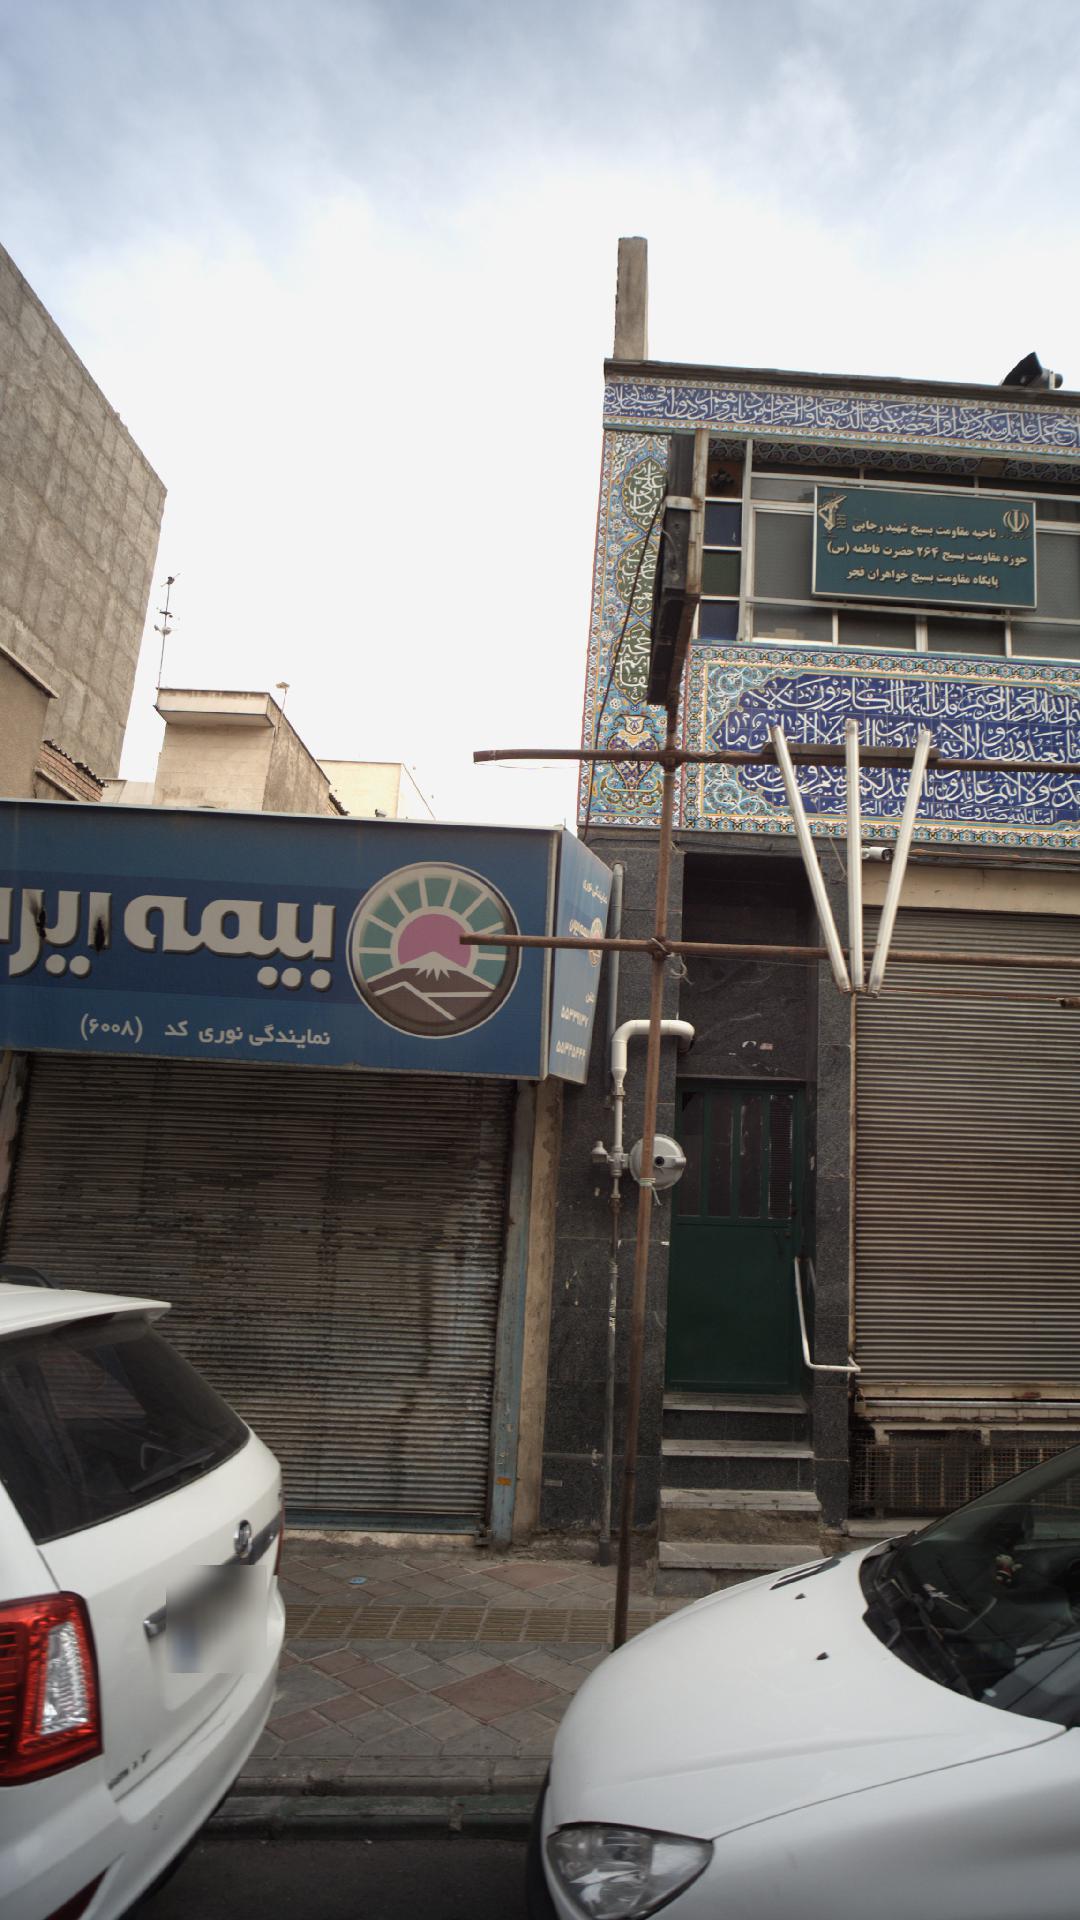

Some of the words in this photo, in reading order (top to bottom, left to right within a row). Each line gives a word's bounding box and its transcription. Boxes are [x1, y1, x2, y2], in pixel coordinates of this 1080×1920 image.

[852, 520, 884, 534] رجایی
[885, 523, 909, 534] شهید
[911, 525, 934, 536] بسیج
[936, 526, 970, 539] مقاومت
[972, 528, 997, 539] ناحیه
[827, 540, 850, 555] (س)
[853, 543, 881, 554] فاطمه
[882, 546, 914, 558] حضرت
[917, 546, 939, 558] ۲۶۴
[942, 551, 965, 563] بسیج
[966, 552, 1001, 564] مقاومت
[1003, 555, 1028, 567] حوزه
[846, 566, 865, 580] فجر
[867, 568, 909, 582] خواهران
[911, 573, 934, 584] بسیج
[936, 573, 971, 587] مقاومت
[0, 887, 112, 977] ایرا
[124, 895, 336, 990] بیمه
[80, 1013, 143, 1043] (۶۰۰۸)
[164, 1020, 189, 1037] کد
[198, 1025, 243, 1045] نوری
[249, 1024, 331, 1049] نمایندگی
